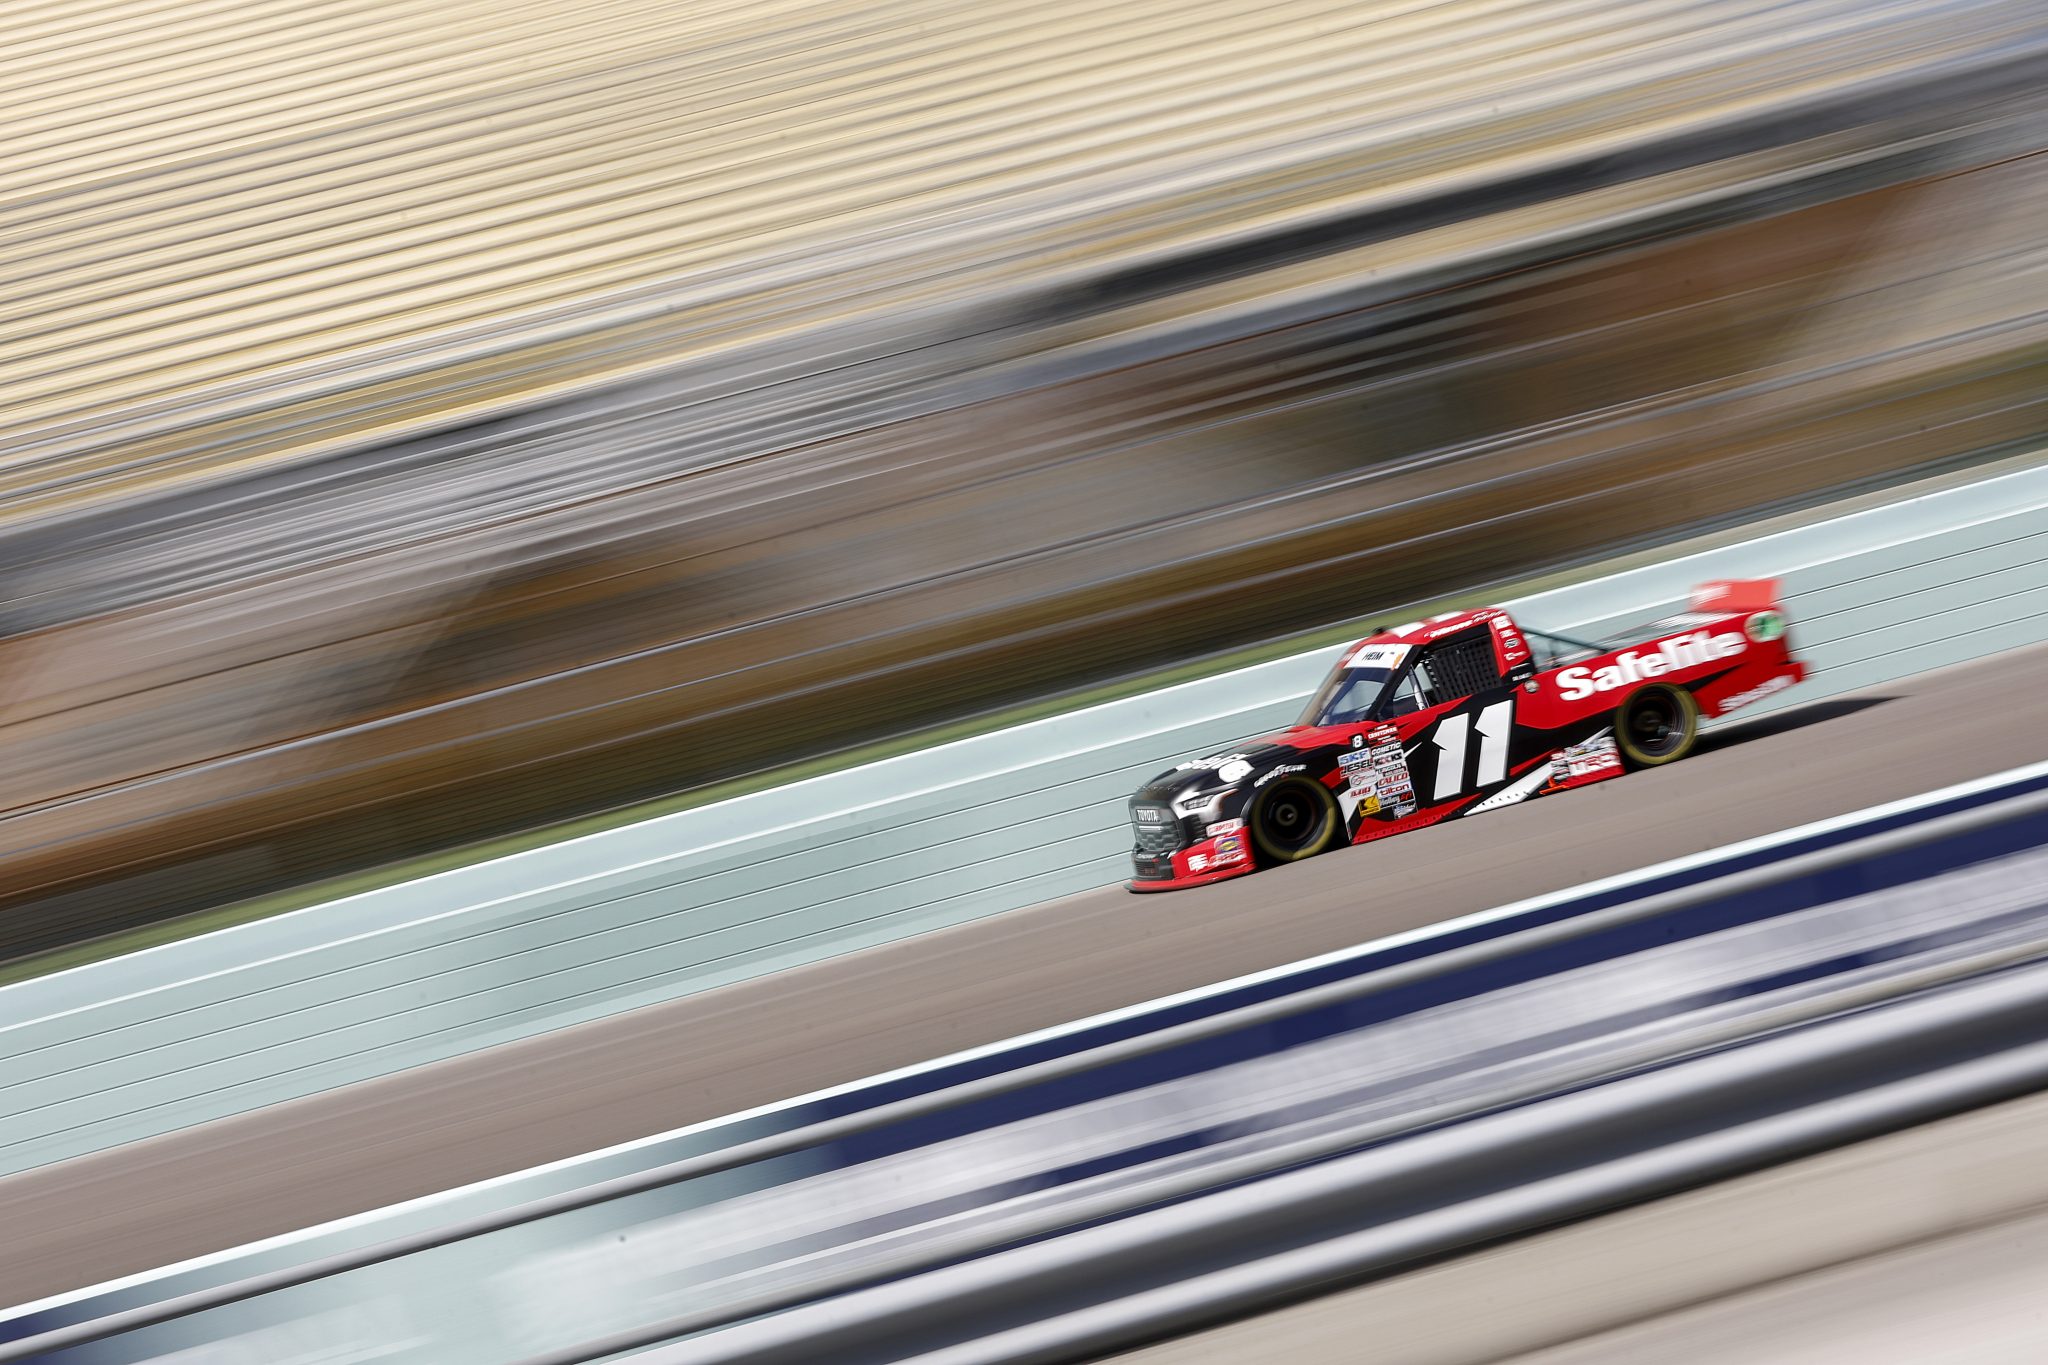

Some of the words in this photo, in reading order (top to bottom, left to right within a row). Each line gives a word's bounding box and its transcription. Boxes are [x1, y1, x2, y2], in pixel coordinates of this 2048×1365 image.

[1363, 651, 1385, 661] HEIM
[1556, 630, 1748, 701] Safelite
[1353, 734, 1363, 748] 8
[1339, 749, 1368, 765] SKF
[1432, 699, 1514, 801] 11
[1340, 759, 1373, 774] JESEL
[1378, 772, 1408, 787] CALICO
[1380, 783, 1409, 796] tilton
[1137, 809, 1160, 822] TOYOTA
